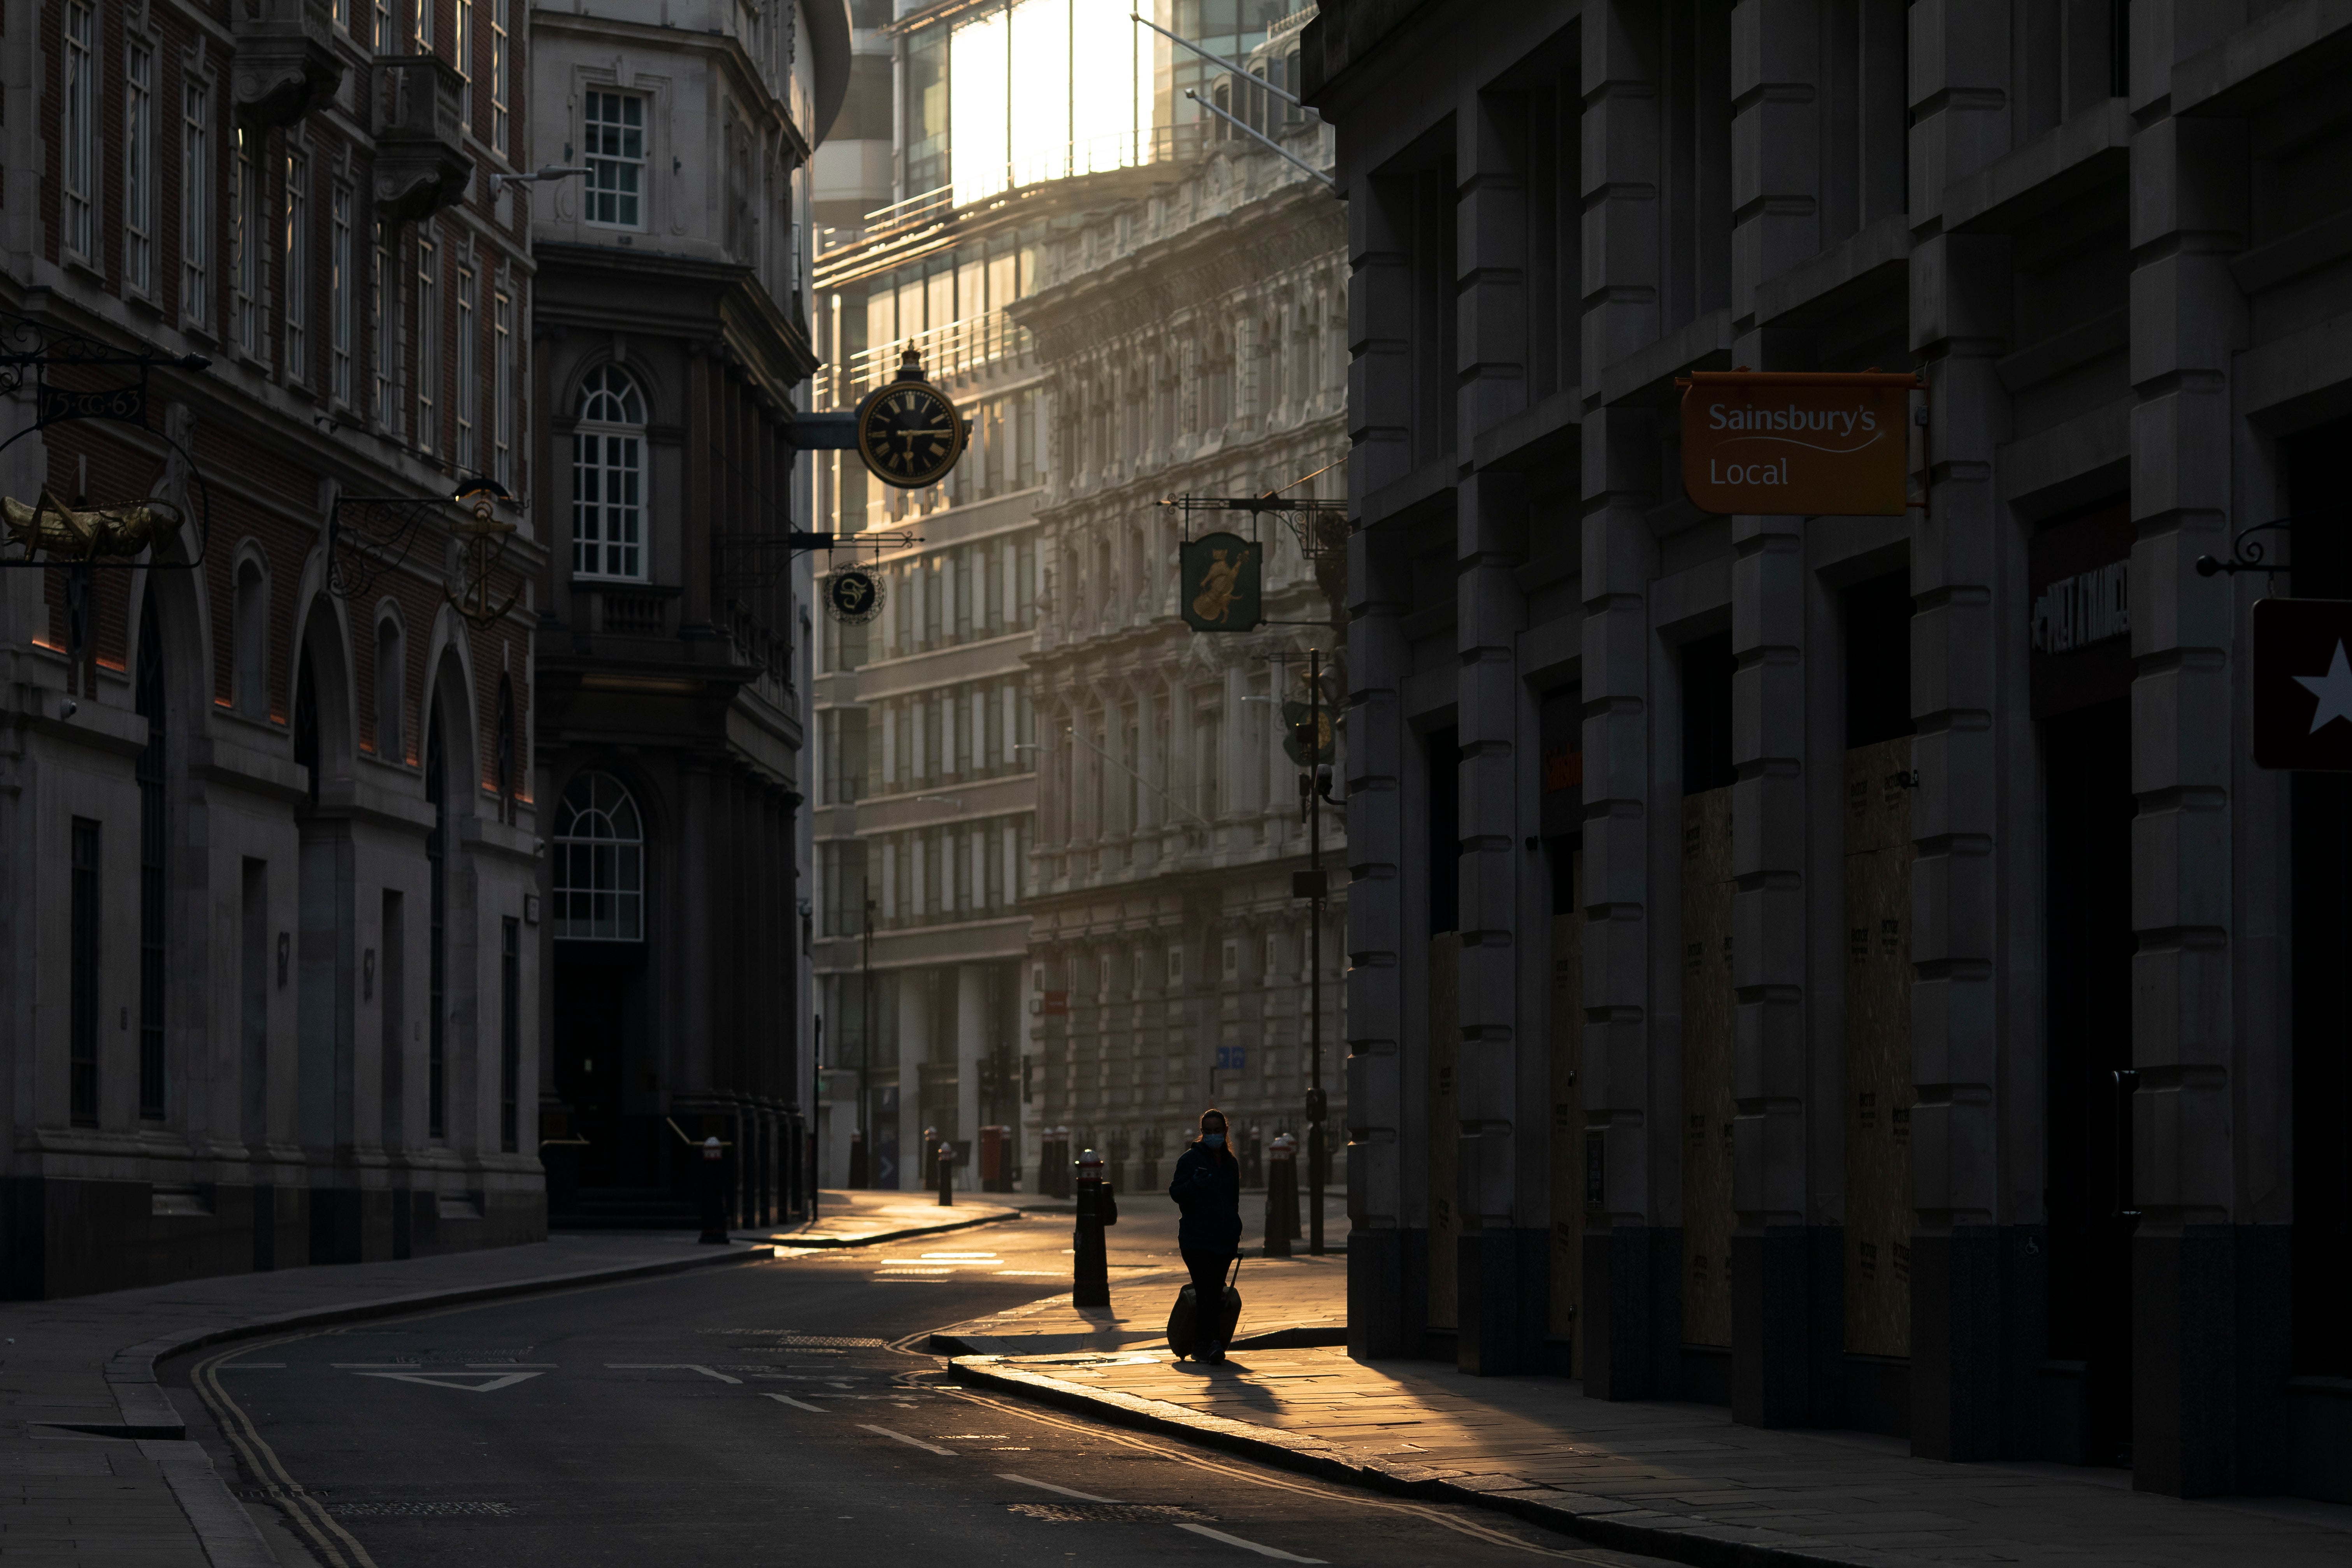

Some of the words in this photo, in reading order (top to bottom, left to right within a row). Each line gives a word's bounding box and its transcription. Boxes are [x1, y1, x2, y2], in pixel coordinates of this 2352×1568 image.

[1709, 404, 1876, 436] Sainsbury's
[1711, 458, 1788, 485] Local
[2047, 576, 2075, 655] PRET
